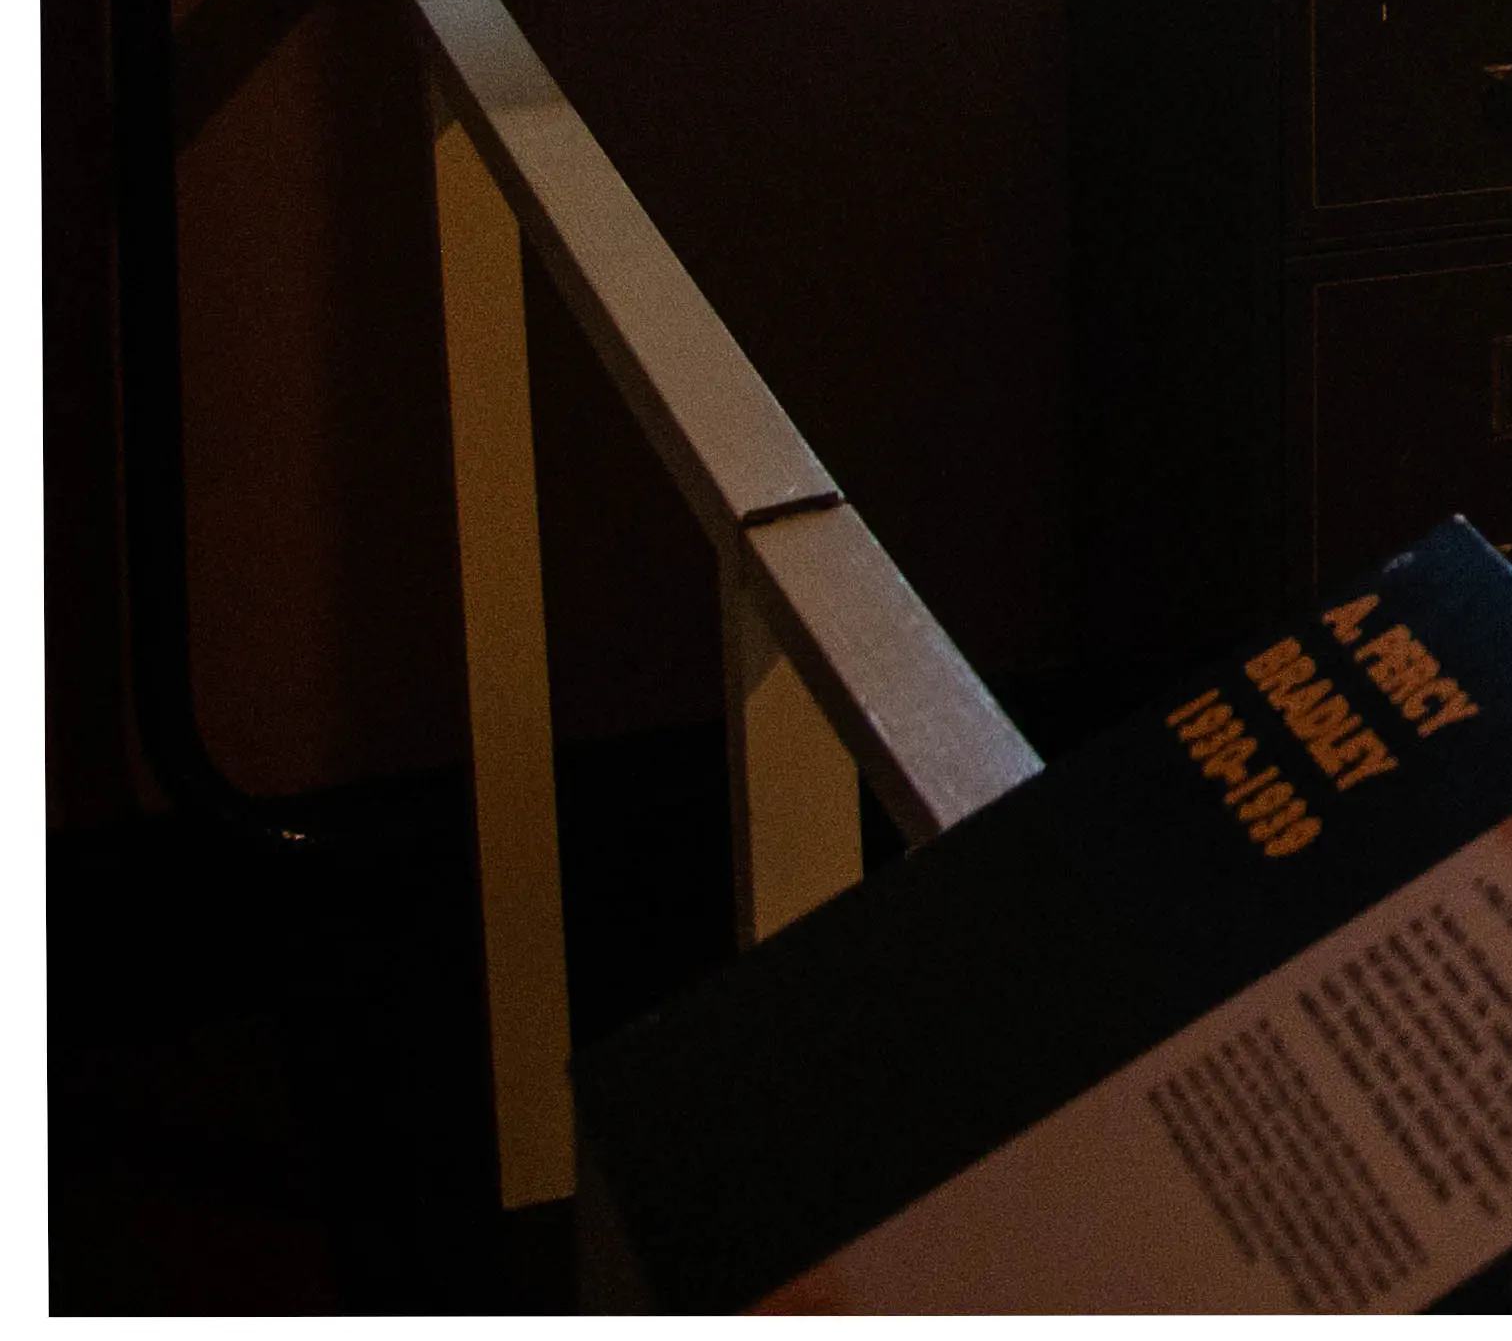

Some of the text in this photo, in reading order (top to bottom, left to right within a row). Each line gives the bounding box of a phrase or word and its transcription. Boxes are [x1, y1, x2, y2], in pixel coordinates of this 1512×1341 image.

[1244, 635, 1400, 792] BRADLEY
[1322, 593, 1480, 739] A. PERCY
